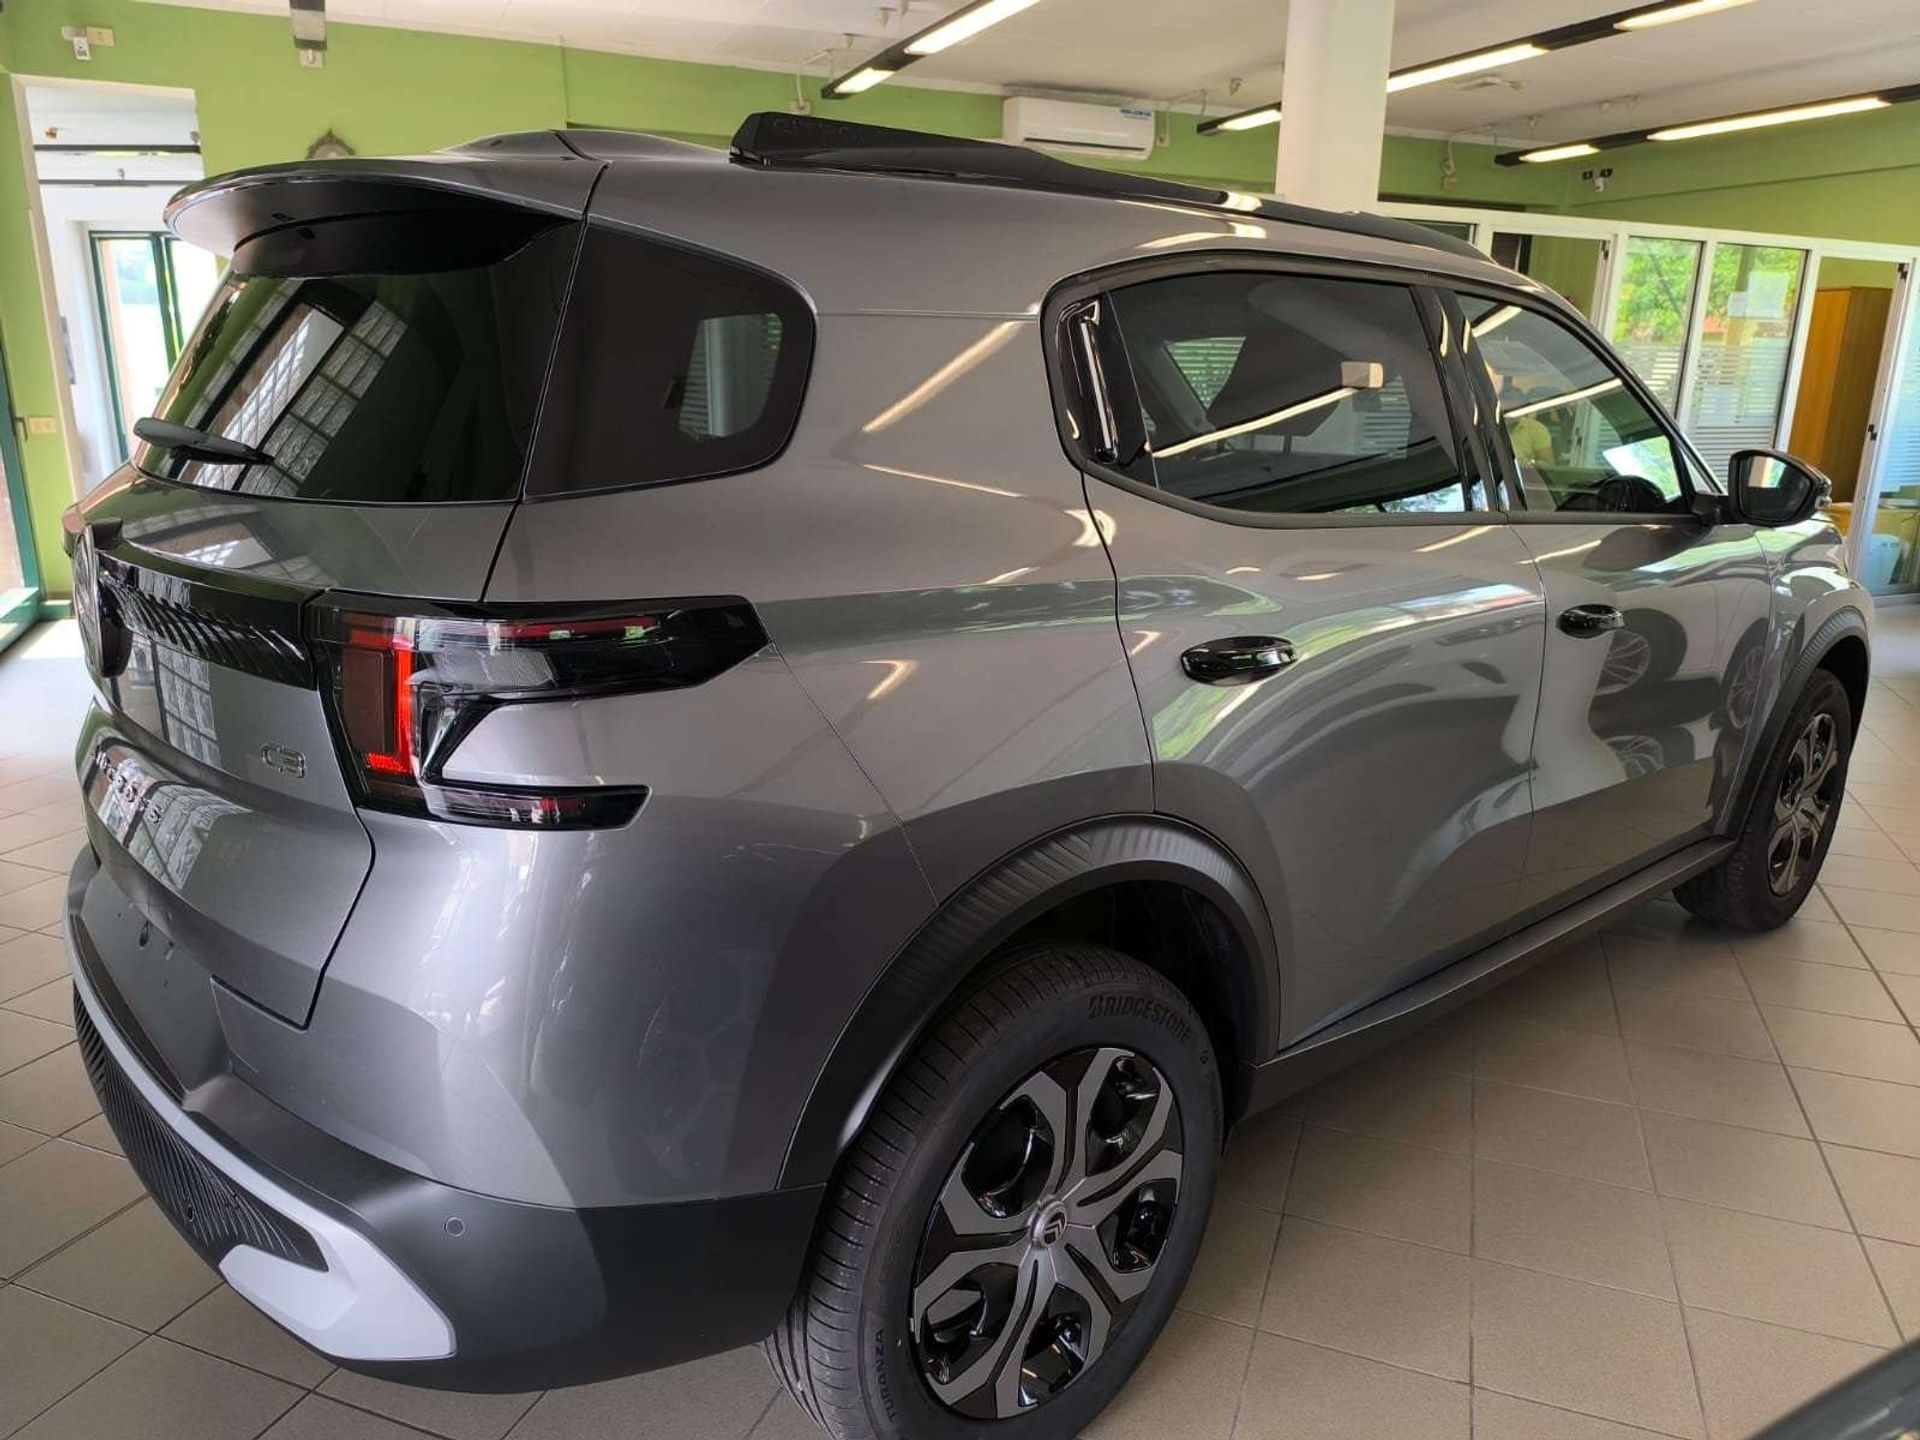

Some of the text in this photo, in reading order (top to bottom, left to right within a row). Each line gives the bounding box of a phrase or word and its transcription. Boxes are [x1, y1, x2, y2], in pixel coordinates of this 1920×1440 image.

[261, 743, 306, 778] C3
[1089, 994, 1192, 1044] BRIDGESTONE
[874, 1327, 900, 1423] TURANZA
